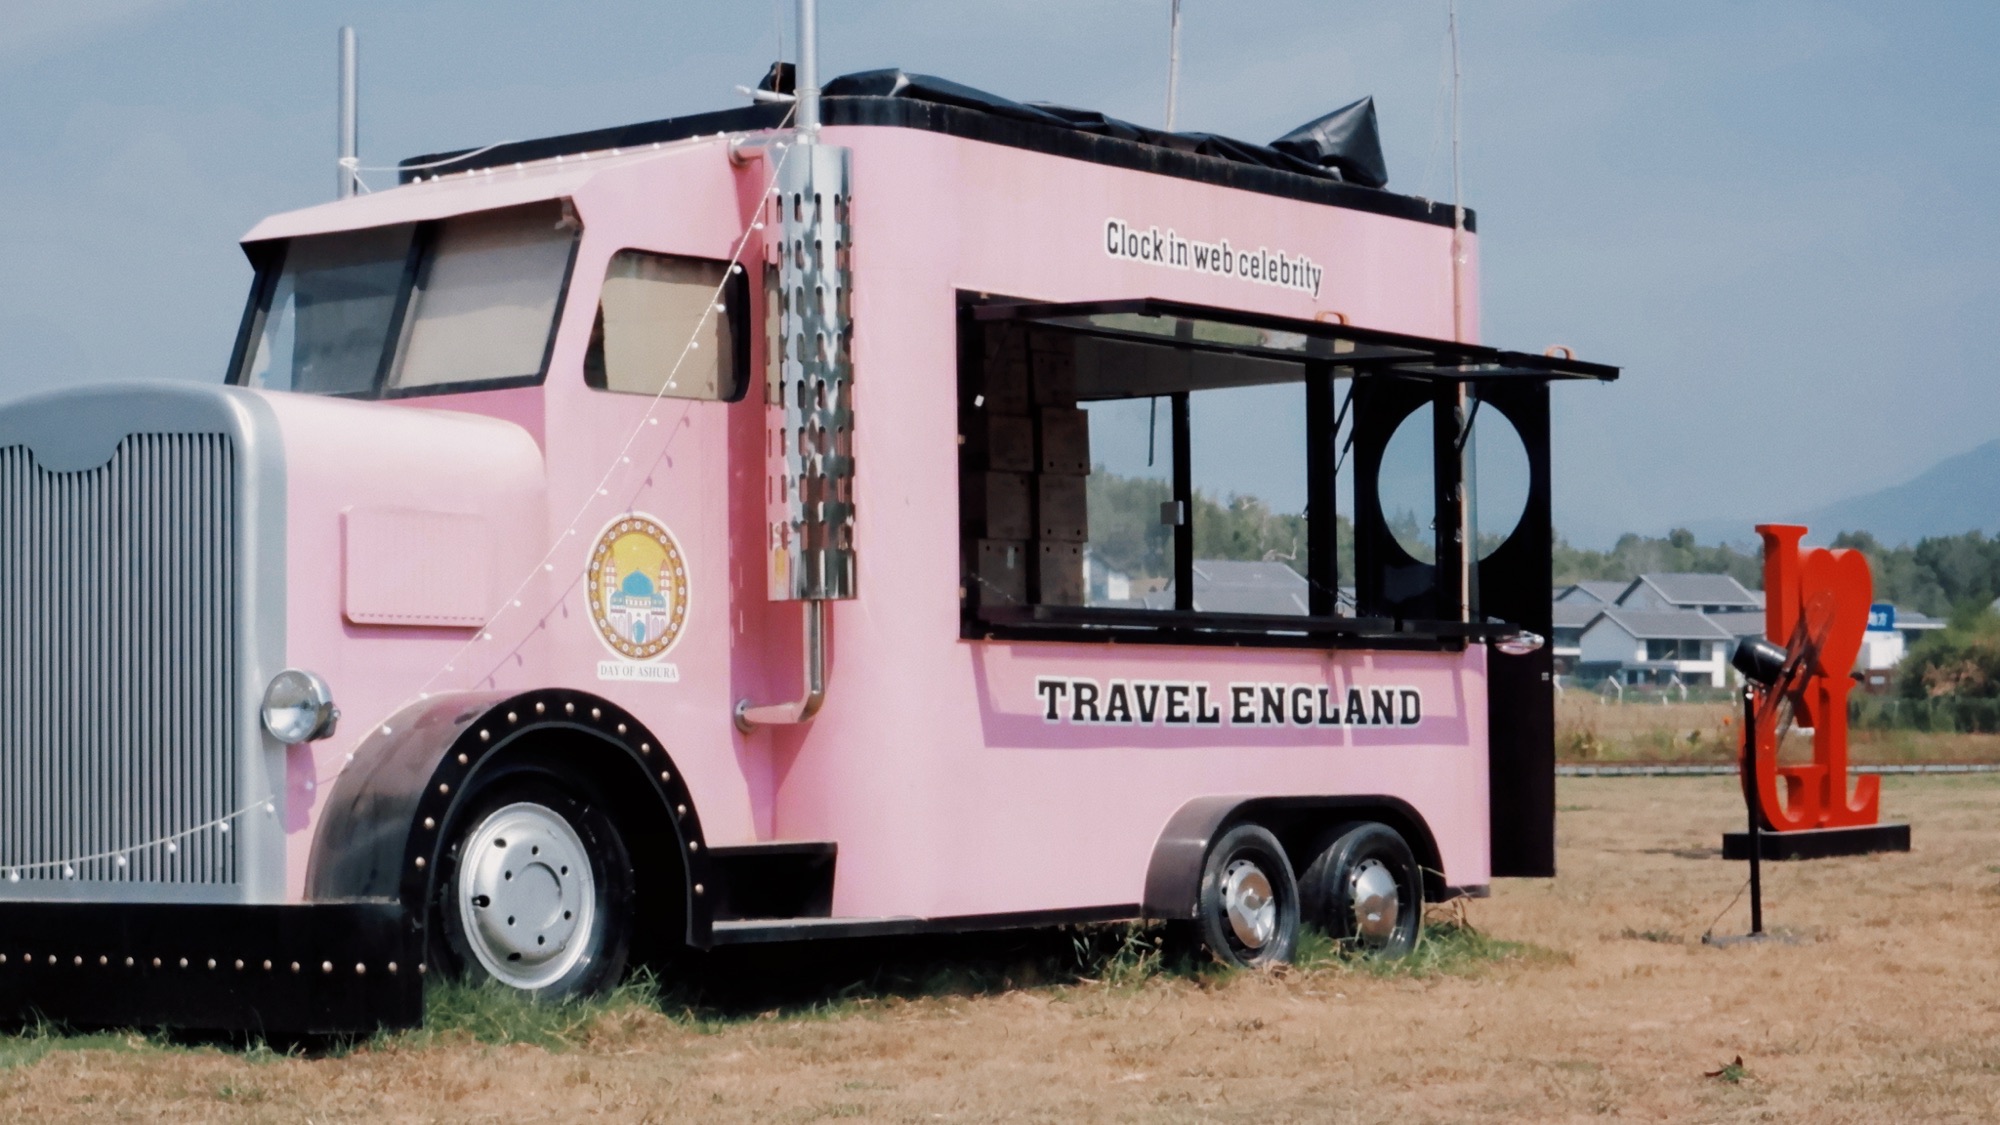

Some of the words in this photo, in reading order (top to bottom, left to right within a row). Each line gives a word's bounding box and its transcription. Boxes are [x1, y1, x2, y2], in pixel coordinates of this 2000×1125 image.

[1106, 220, 1164, 263] Clock
[1169, 232, 1189, 267] in
[1193, 241, 1233, 275] web
[1238, 249, 1322, 298] celebrity
[600, 665, 619, 677] DAY
[622, 665, 634, 677] OF
[638, 666, 676, 679] ASHURA
[1037, 679, 1221, 724] TRAVEL
[1230, 686, 1422, 726] ENGLAND
